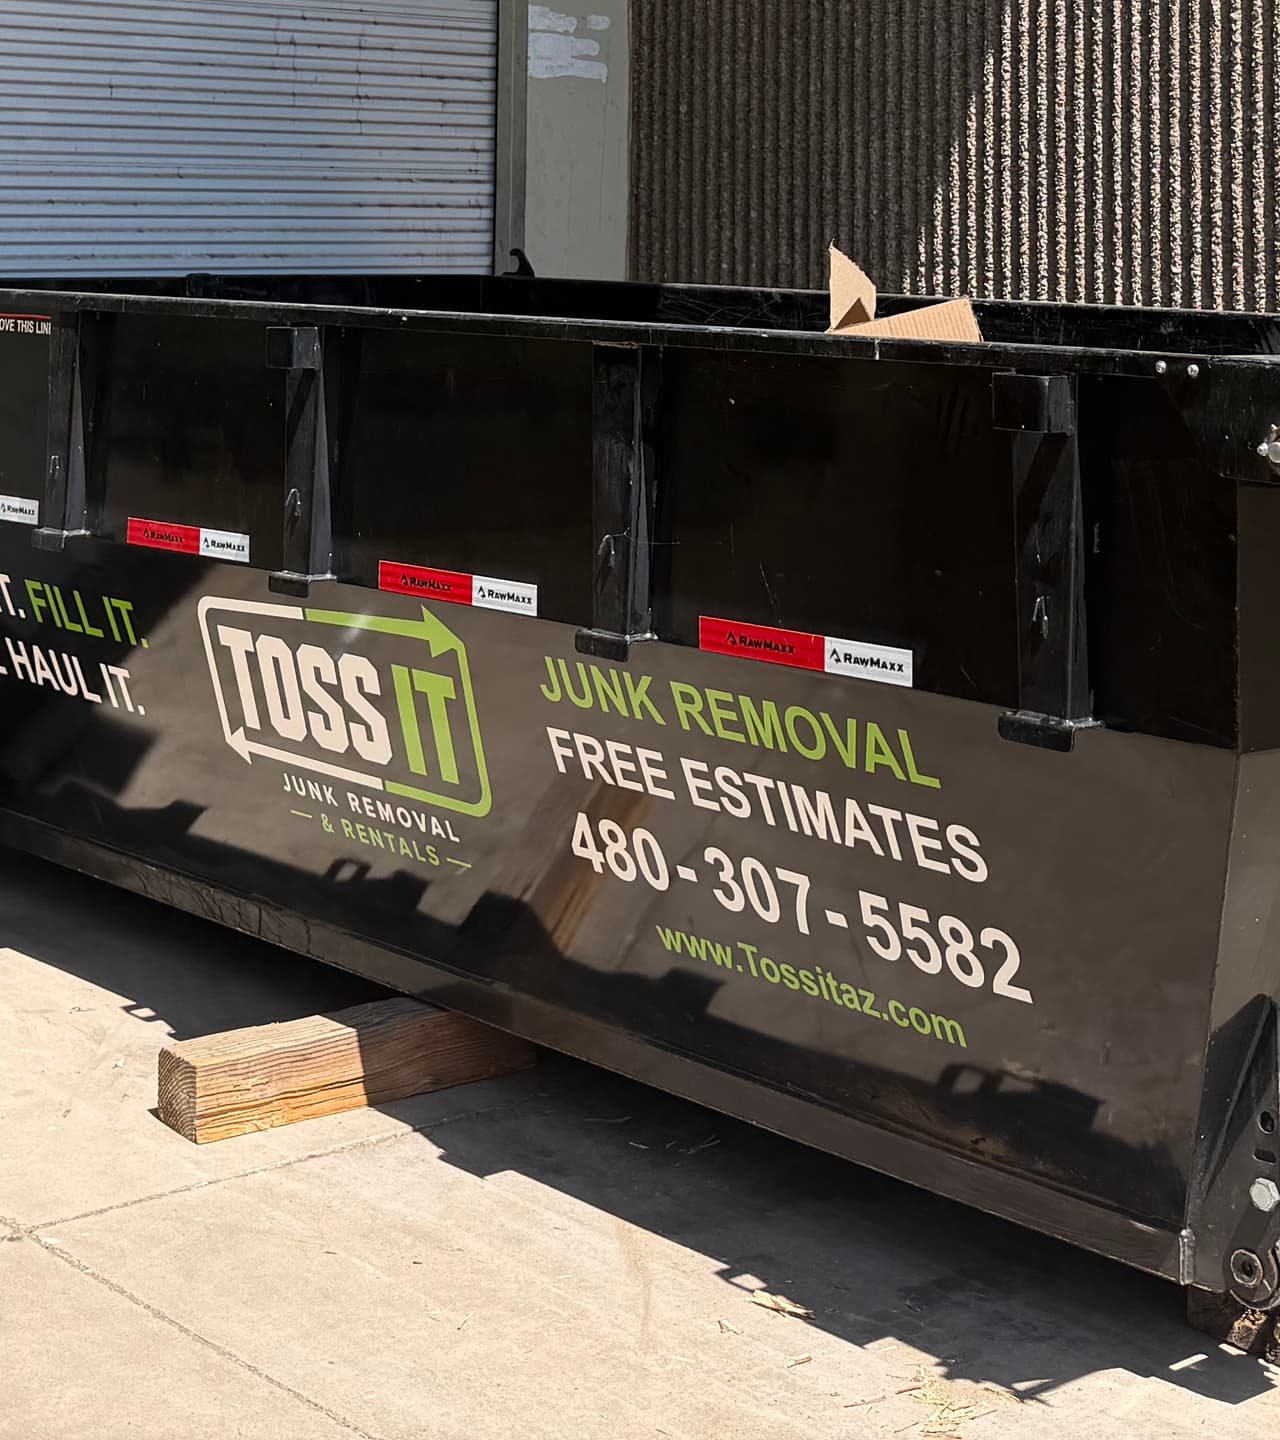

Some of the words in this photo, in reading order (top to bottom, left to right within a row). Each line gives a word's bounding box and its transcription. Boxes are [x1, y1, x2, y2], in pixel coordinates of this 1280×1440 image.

[16, 319, 35, 334] THIS
[24, 579, 105, 639] FILL
[102, 596, 150, 649] IT.
[5, 637, 103, 704] HAUL
[99, 662, 146, 716] IT.
[217, 624, 393, 766] TOSS
[390, 663, 460, 785] IT
[539, 656, 665, 726] JUNK
[669, 681, 942, 789] REMOVAL
[283, 773, 338, 807] JUNK
[346, 791, 461, 843] REMOVAL
[320, 813, 334, 833] &
[341, 818, 441, 866] RENTALS
[546, 726, 676, 801] FREE
[679, 757, 989, 883] ESTIMATES
